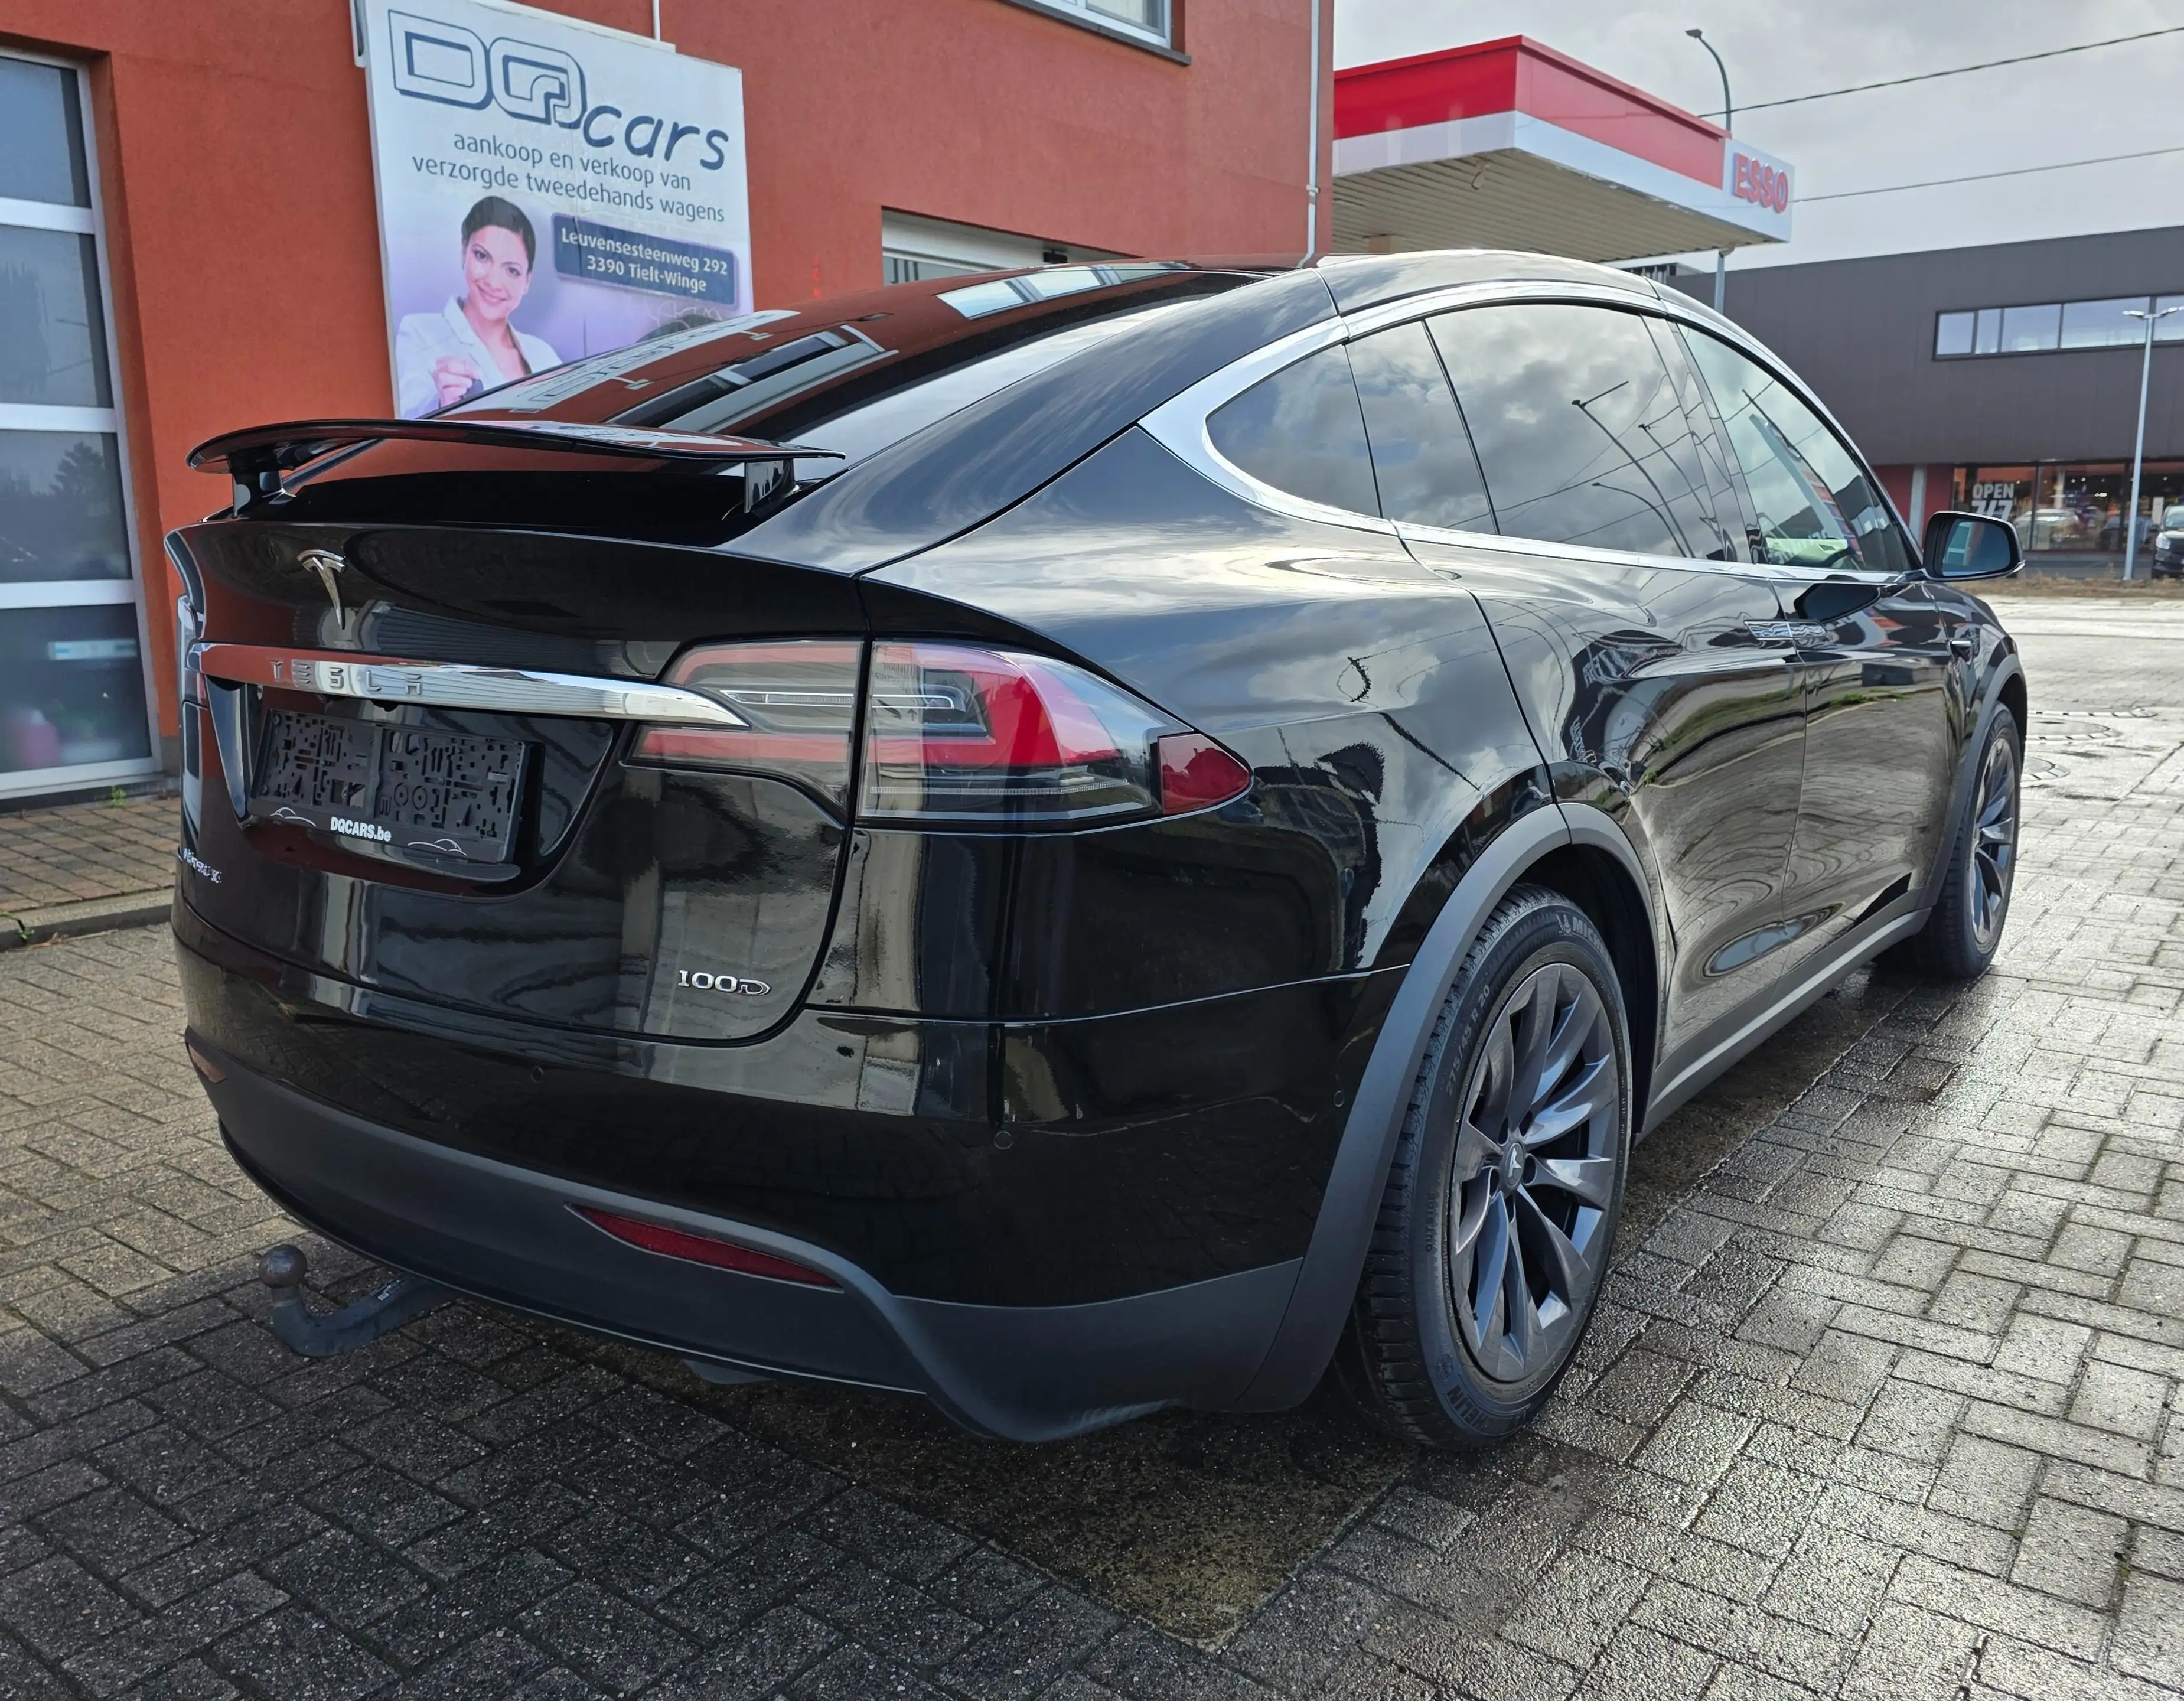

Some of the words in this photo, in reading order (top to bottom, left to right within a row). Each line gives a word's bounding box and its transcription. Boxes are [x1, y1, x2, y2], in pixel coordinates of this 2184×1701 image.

[454, 133, 543, 169] aankoop
[550, 152, 573, 170] en
[580, 157, 654, 188] verkoop
[660, 172, 691, 191] van
[412, 156, 519, 190] verzorgde
[526, 172, 653, 210] tweedehands
[660, 198, 725, 223] wagens
[1732, 152, 1789, 214] ESSO
[562, 227, 699, 273] Leuvensesteenweg
[703, 258, 728, 275] 292
[587, 255, 625, 276] 3390
[628, 263, 707, 294] Tielt-Winge
[1972, 483, 2014, 499] OPEN
[330, 816, 392, 842] DQCARS.be
[678, 970, 772, 996] 100D
[1471, 1008, 1479, 1022] R
[1478, 984, 1491, 1008] 20
